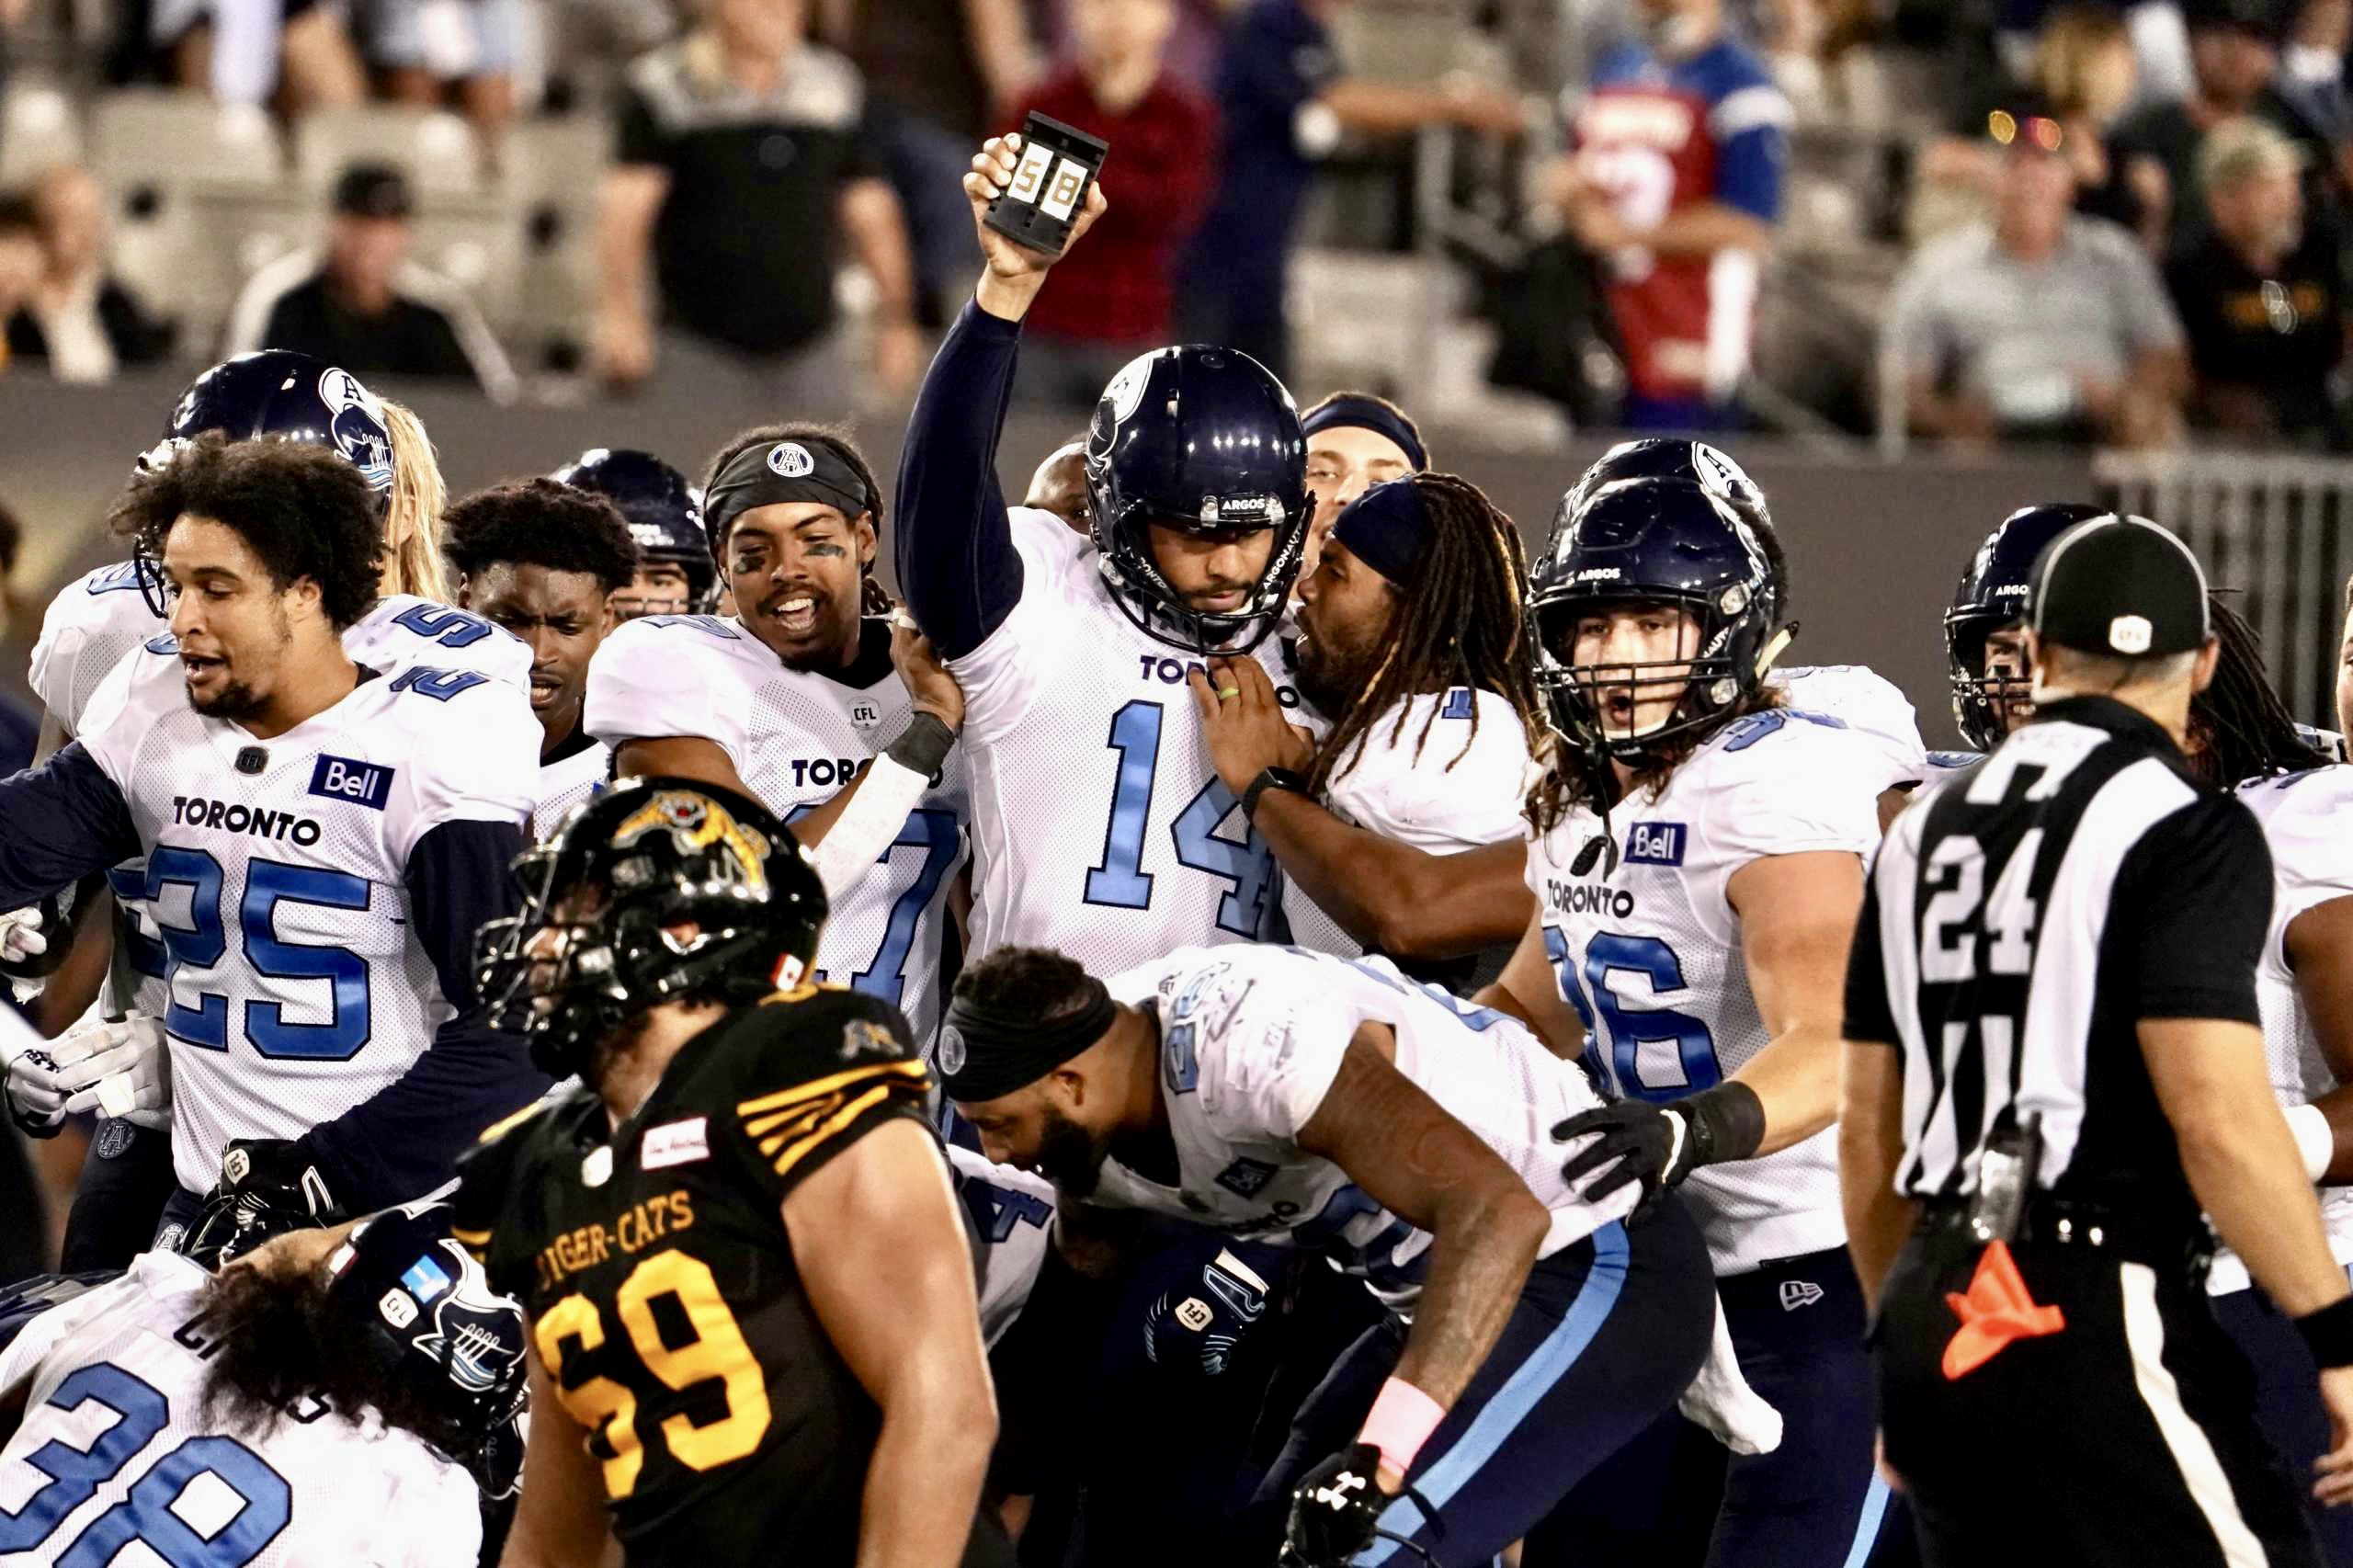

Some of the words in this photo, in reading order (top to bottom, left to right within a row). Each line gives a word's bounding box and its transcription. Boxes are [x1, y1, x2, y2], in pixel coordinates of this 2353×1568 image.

[1015, 159, 1081, 206] 58
[1222, 498, 1266, 510] ARGOS
[1576, 567, 1621, 581] ARGOS
[1995, 584, 2029, 597] ARGO
[853, 707, 877, 722] CFL
[324, 760, 380, 801] Bell
[173, 796, 322, 847] TORONTO
[1082, 699, 1274, 940] 14
[1634, 825, 1677, 860] Bell
[1547, 879, 1635, 919] TORONTO
[1921, 827, 2039, 983] 24
[144, 844, 372, 1062] 25
[1184, 1301, 1207, 1324] CFL
[535, 1247, 773, 1499] 69
[0, 1359, 293, 1568] 38
